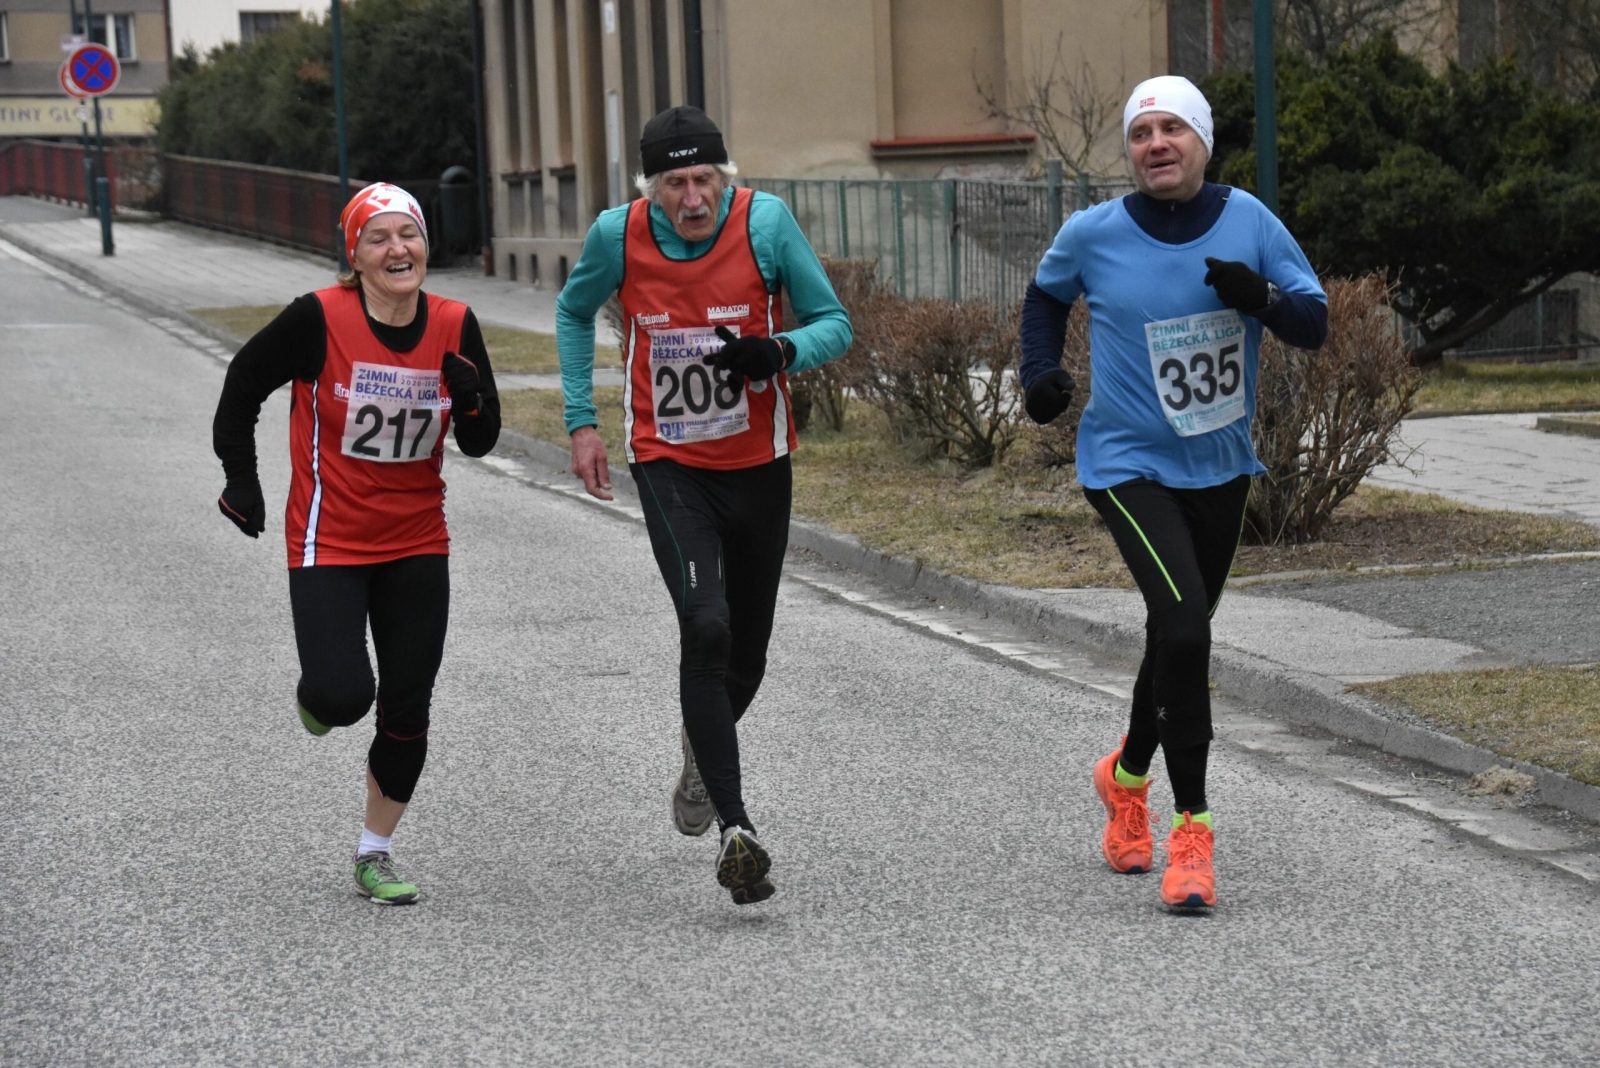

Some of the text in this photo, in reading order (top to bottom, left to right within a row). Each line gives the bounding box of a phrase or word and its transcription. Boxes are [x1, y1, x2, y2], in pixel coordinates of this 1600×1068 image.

[707, 303, 750, 314] MARATON
[1151, 319, 1191, 338] ZIMNÍ
[653, 332, 685, 346] ZIMNÍ
[1152, 333, 1210, 352] BĚŽECKÁ
[1215, 325, 1242, 340] LIGA
[652, 345, 704, 359] BĚŽECKÁ
[357, 368, 398, 384] ZIMNÍ
[1159, 343, 1241, 411] 335
[355, 382, 413, 399] BĚŽECKÁ
[417, 389, 438, 401] LIGA
[655, 363, 742, 418] 208
[350, 404, 433, 458] 217
